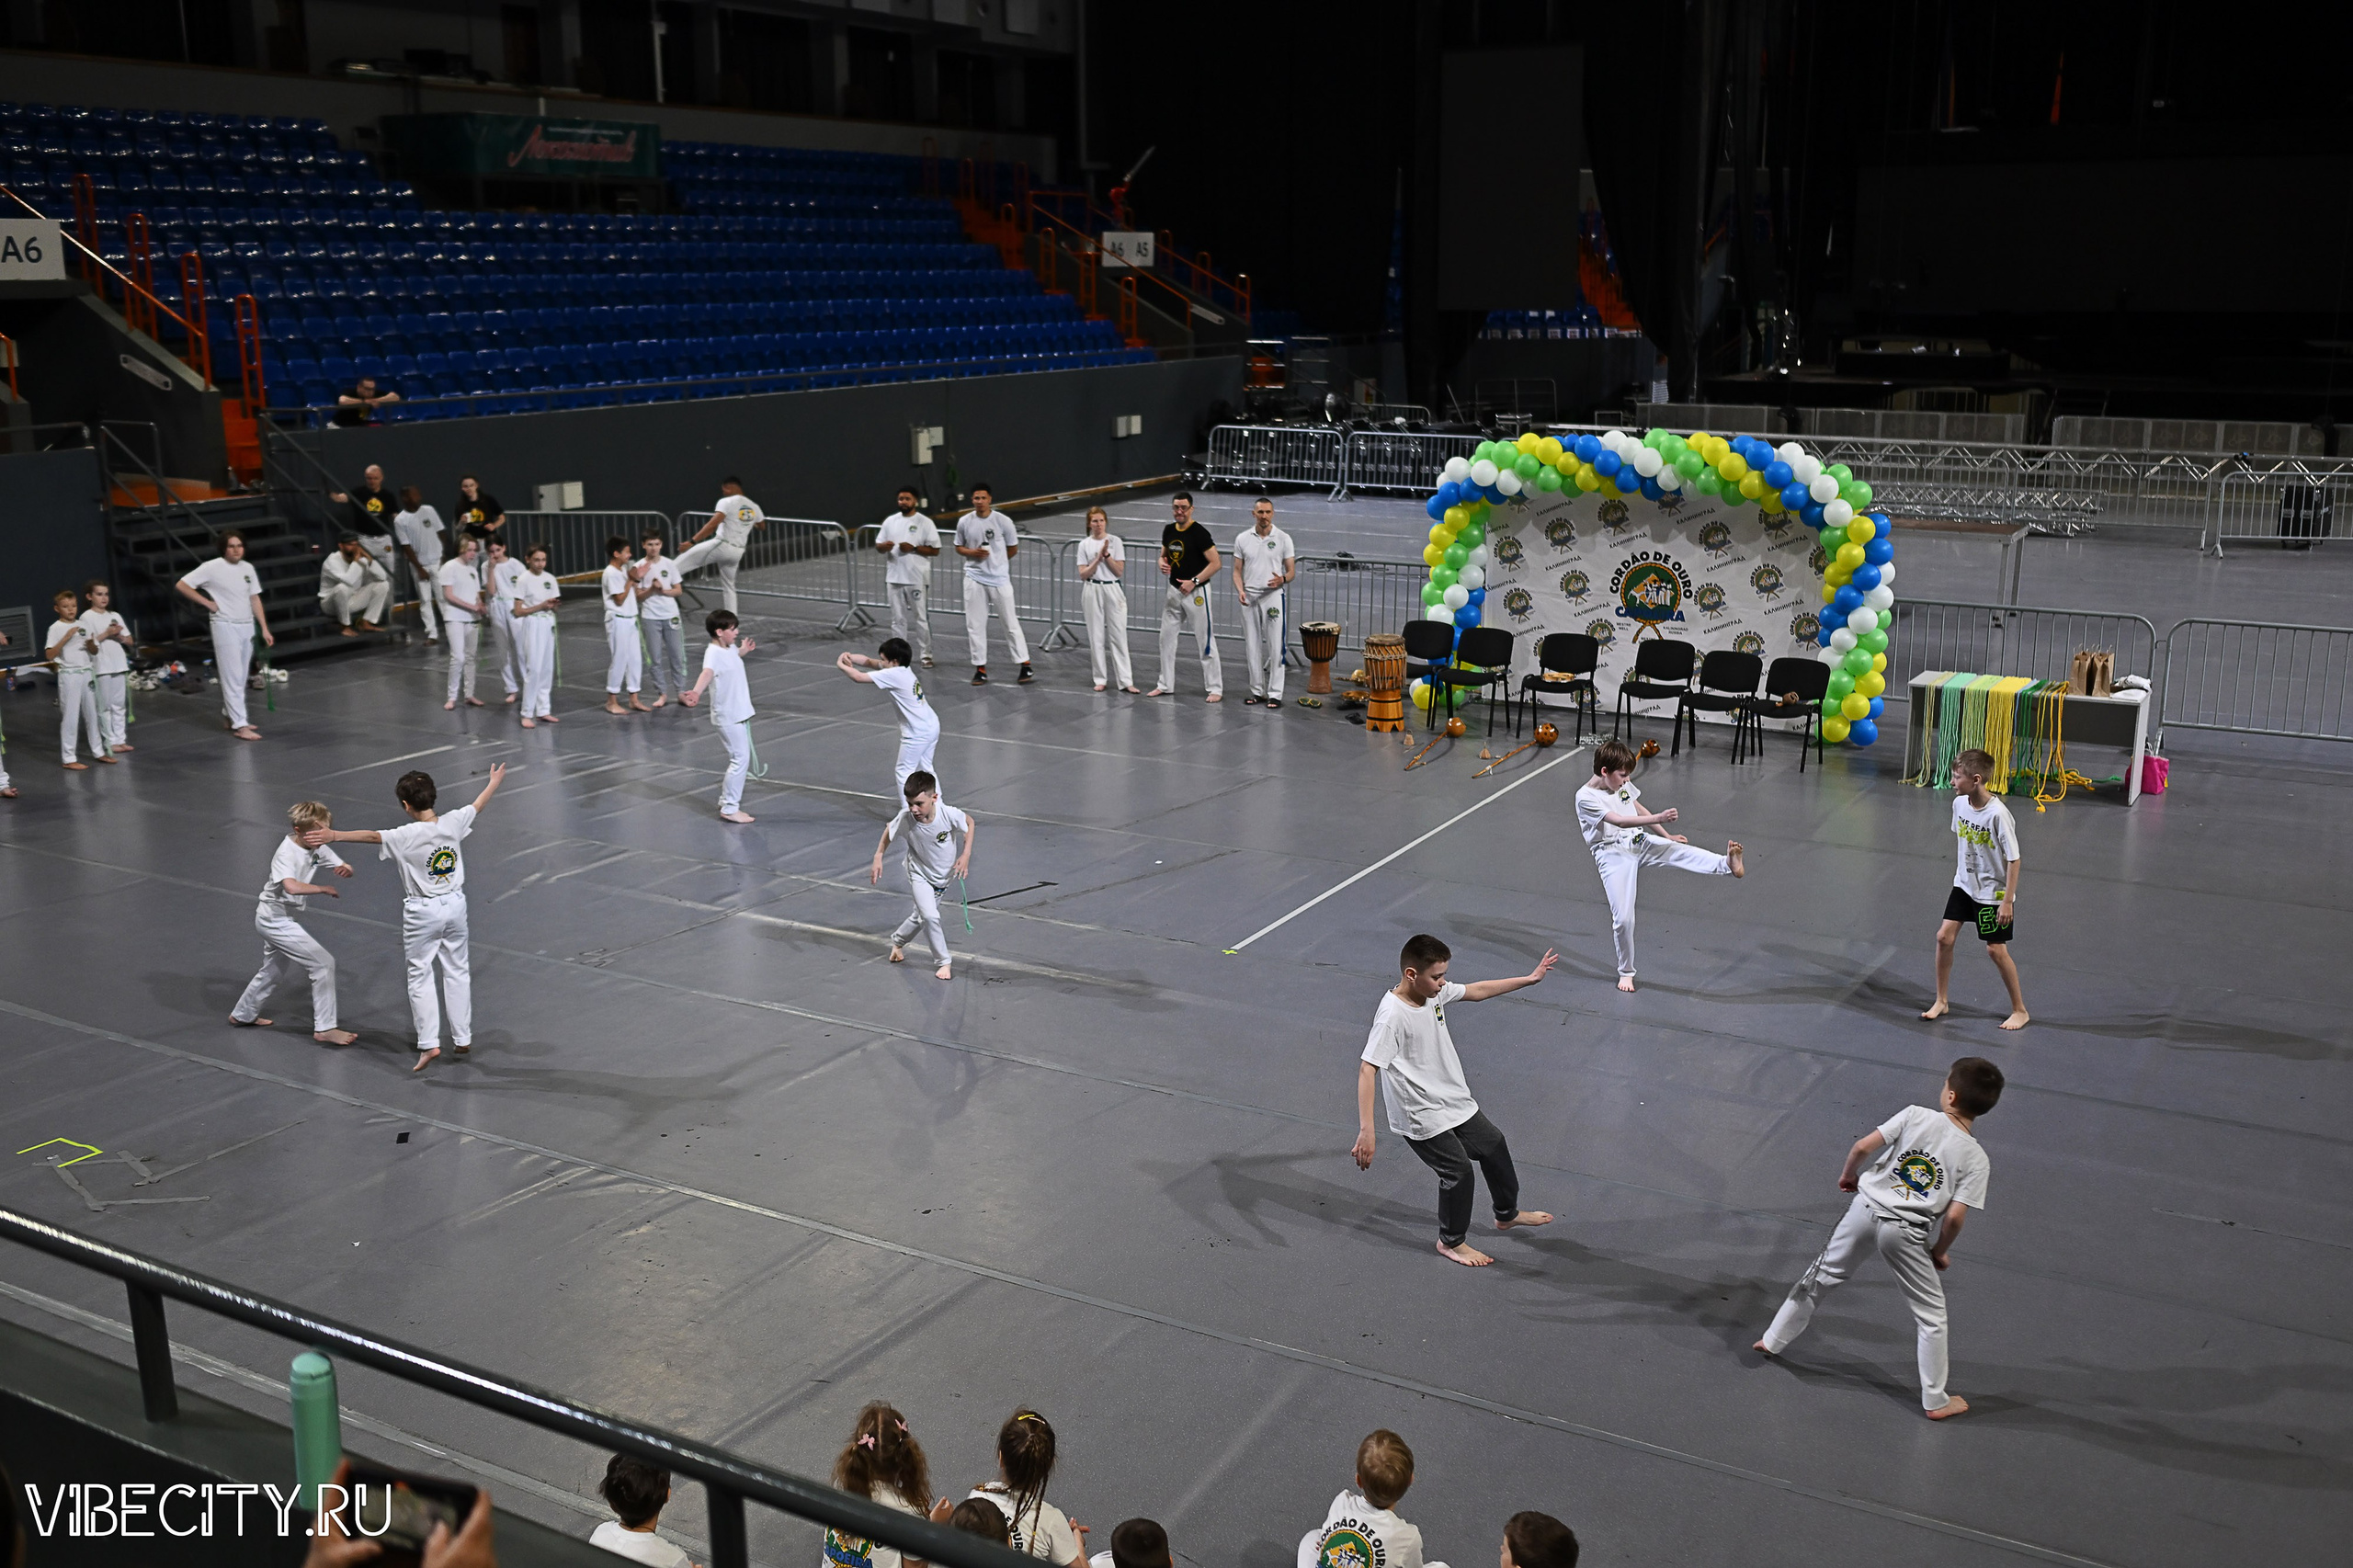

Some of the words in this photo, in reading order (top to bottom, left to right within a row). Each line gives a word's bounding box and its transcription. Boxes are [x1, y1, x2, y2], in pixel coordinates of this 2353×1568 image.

[1, 235, 42, 263] A6
[1609, 551, 1650, 595] CORDÃO
[1653, 551, 1671, 565] DE
[1672, 562, 1693, 599] OURO
[1897, 1149, 1930, 1163] CORDÃO
[1930, 1157, 1941, 1167] DE
[1934, 1167, 1944, 1190] OURO
[1358, 1522, 1376, 1540] DE
[1372, 1538, 1386, 1568] OUR
